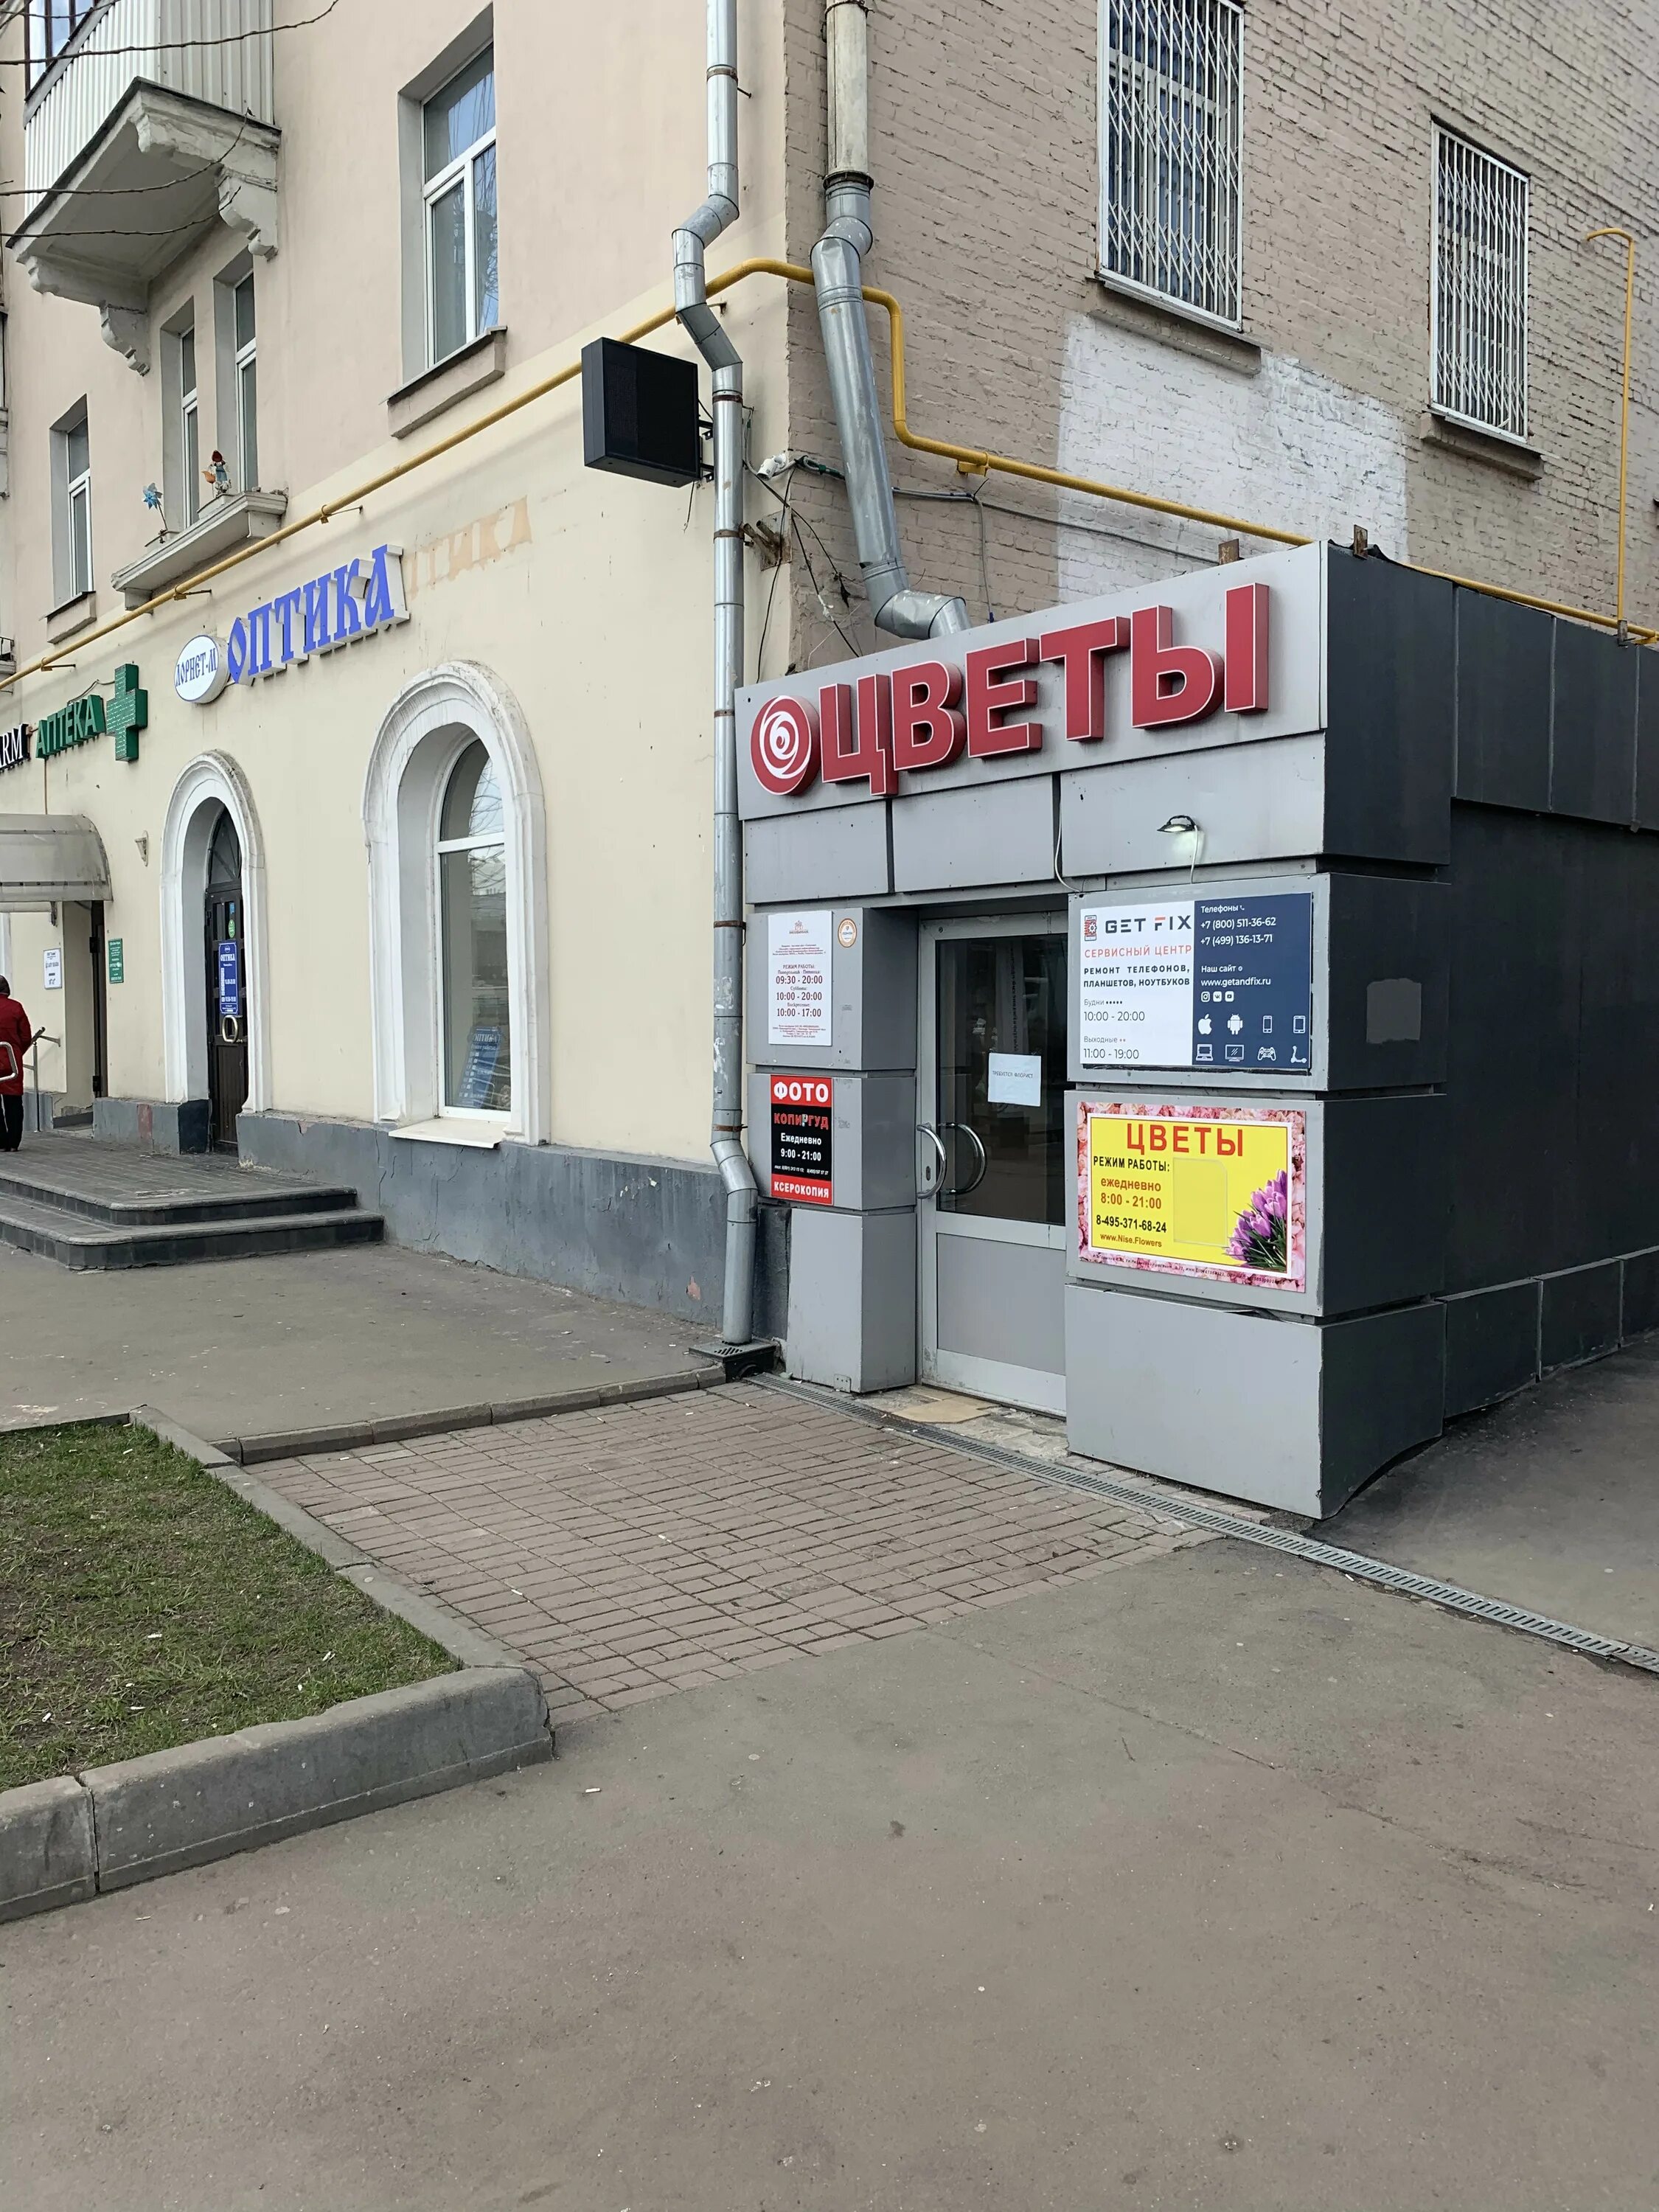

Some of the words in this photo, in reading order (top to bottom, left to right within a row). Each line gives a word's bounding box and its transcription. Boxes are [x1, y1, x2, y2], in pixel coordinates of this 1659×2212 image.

[228, 543, 402, 686] ОПТИКА
[819, 582, 1269, 796] ЦВЕТЫ
[36, 695, 103, 758] АПТЕКА
[0, 723, 27, 768] RM
[1200, 905, 1239, 914] Телефоны
[1105, 917, 1147, 934] GET
[1154, 914, 1192, 931] FIX
[1200, 921, 1211, 930] +7
[1213, 919, 1235, 931] (800)
[1237, 917, 1276, 928] 511-36-62
[1200, 937, 1211, 945] +7
[1212, 936, 1234, 947] (499)
[1236, 933, 1273, 945] 136-13-71
[1085, 945, 1150, 958] СЕРВИСНЫЙ
[1155, 945, 1192, 956] ЦЕНТР
[1084, 967, 1120, 975] РЕМОНТ
[1127, 964, 1190, 974] ТЕЛЕФОНОВ,
[1201, 965, 1217, 973] Наш
[1219, 964, 1237, 973] сайт
[776, 975, 796, 984] 09:30
[802, 975, 823, 984] 20:00
[1083, 979, 1136, 988] ПЛАНШЕТОВ,
[1139, 978, 1190, 987] НОУТБУКОВ
[1200, 977, 1271, 987] www.getandfix.ru
[776, 992, 796, 1001] 10:00
[801, 992, 822, 1000] 20:00
[777, 1008, 796, 1017] 10:00
[802, 1008, 821, 1017] 17:00
[1084, 1011, 1108, 1021] 10:00
[1117, 1011, 1145, 1021] 20:00
[1084, 1036, 1118, 1044] Выходные
[1084, 1048, 1105, 1059] 11:00
[1114, 1048, 1139, 1059] 19:00
[773, 1081, 829, 1103] ФОТО
[780, 1133, 822, 1145] Ежедневно
[1127, 1123, 1243, 1157] ЦВЕТЫ
[780, 1148, 796, 1158] 9:00
[801, 1150, 821, 1161] 21:00
[1093, 1156, 1125, 1169] РЕЖИМ
[1127, 1158, 1170, 1172] РАБОТЫ:
[773, 1181, 830, 1198] КСЕРОКОПИЯ
[1100, 1177, 1161, 1192] ежедневно
[1100, 1192, 1123, 1206] 8:00
[1132, 1194, 1162, 1209] 21:00
[1096, 1214, 1167, 1233] 8-495-371-68-24
[1100, 1233, 1162, 1248] www.Nise.Flowers
